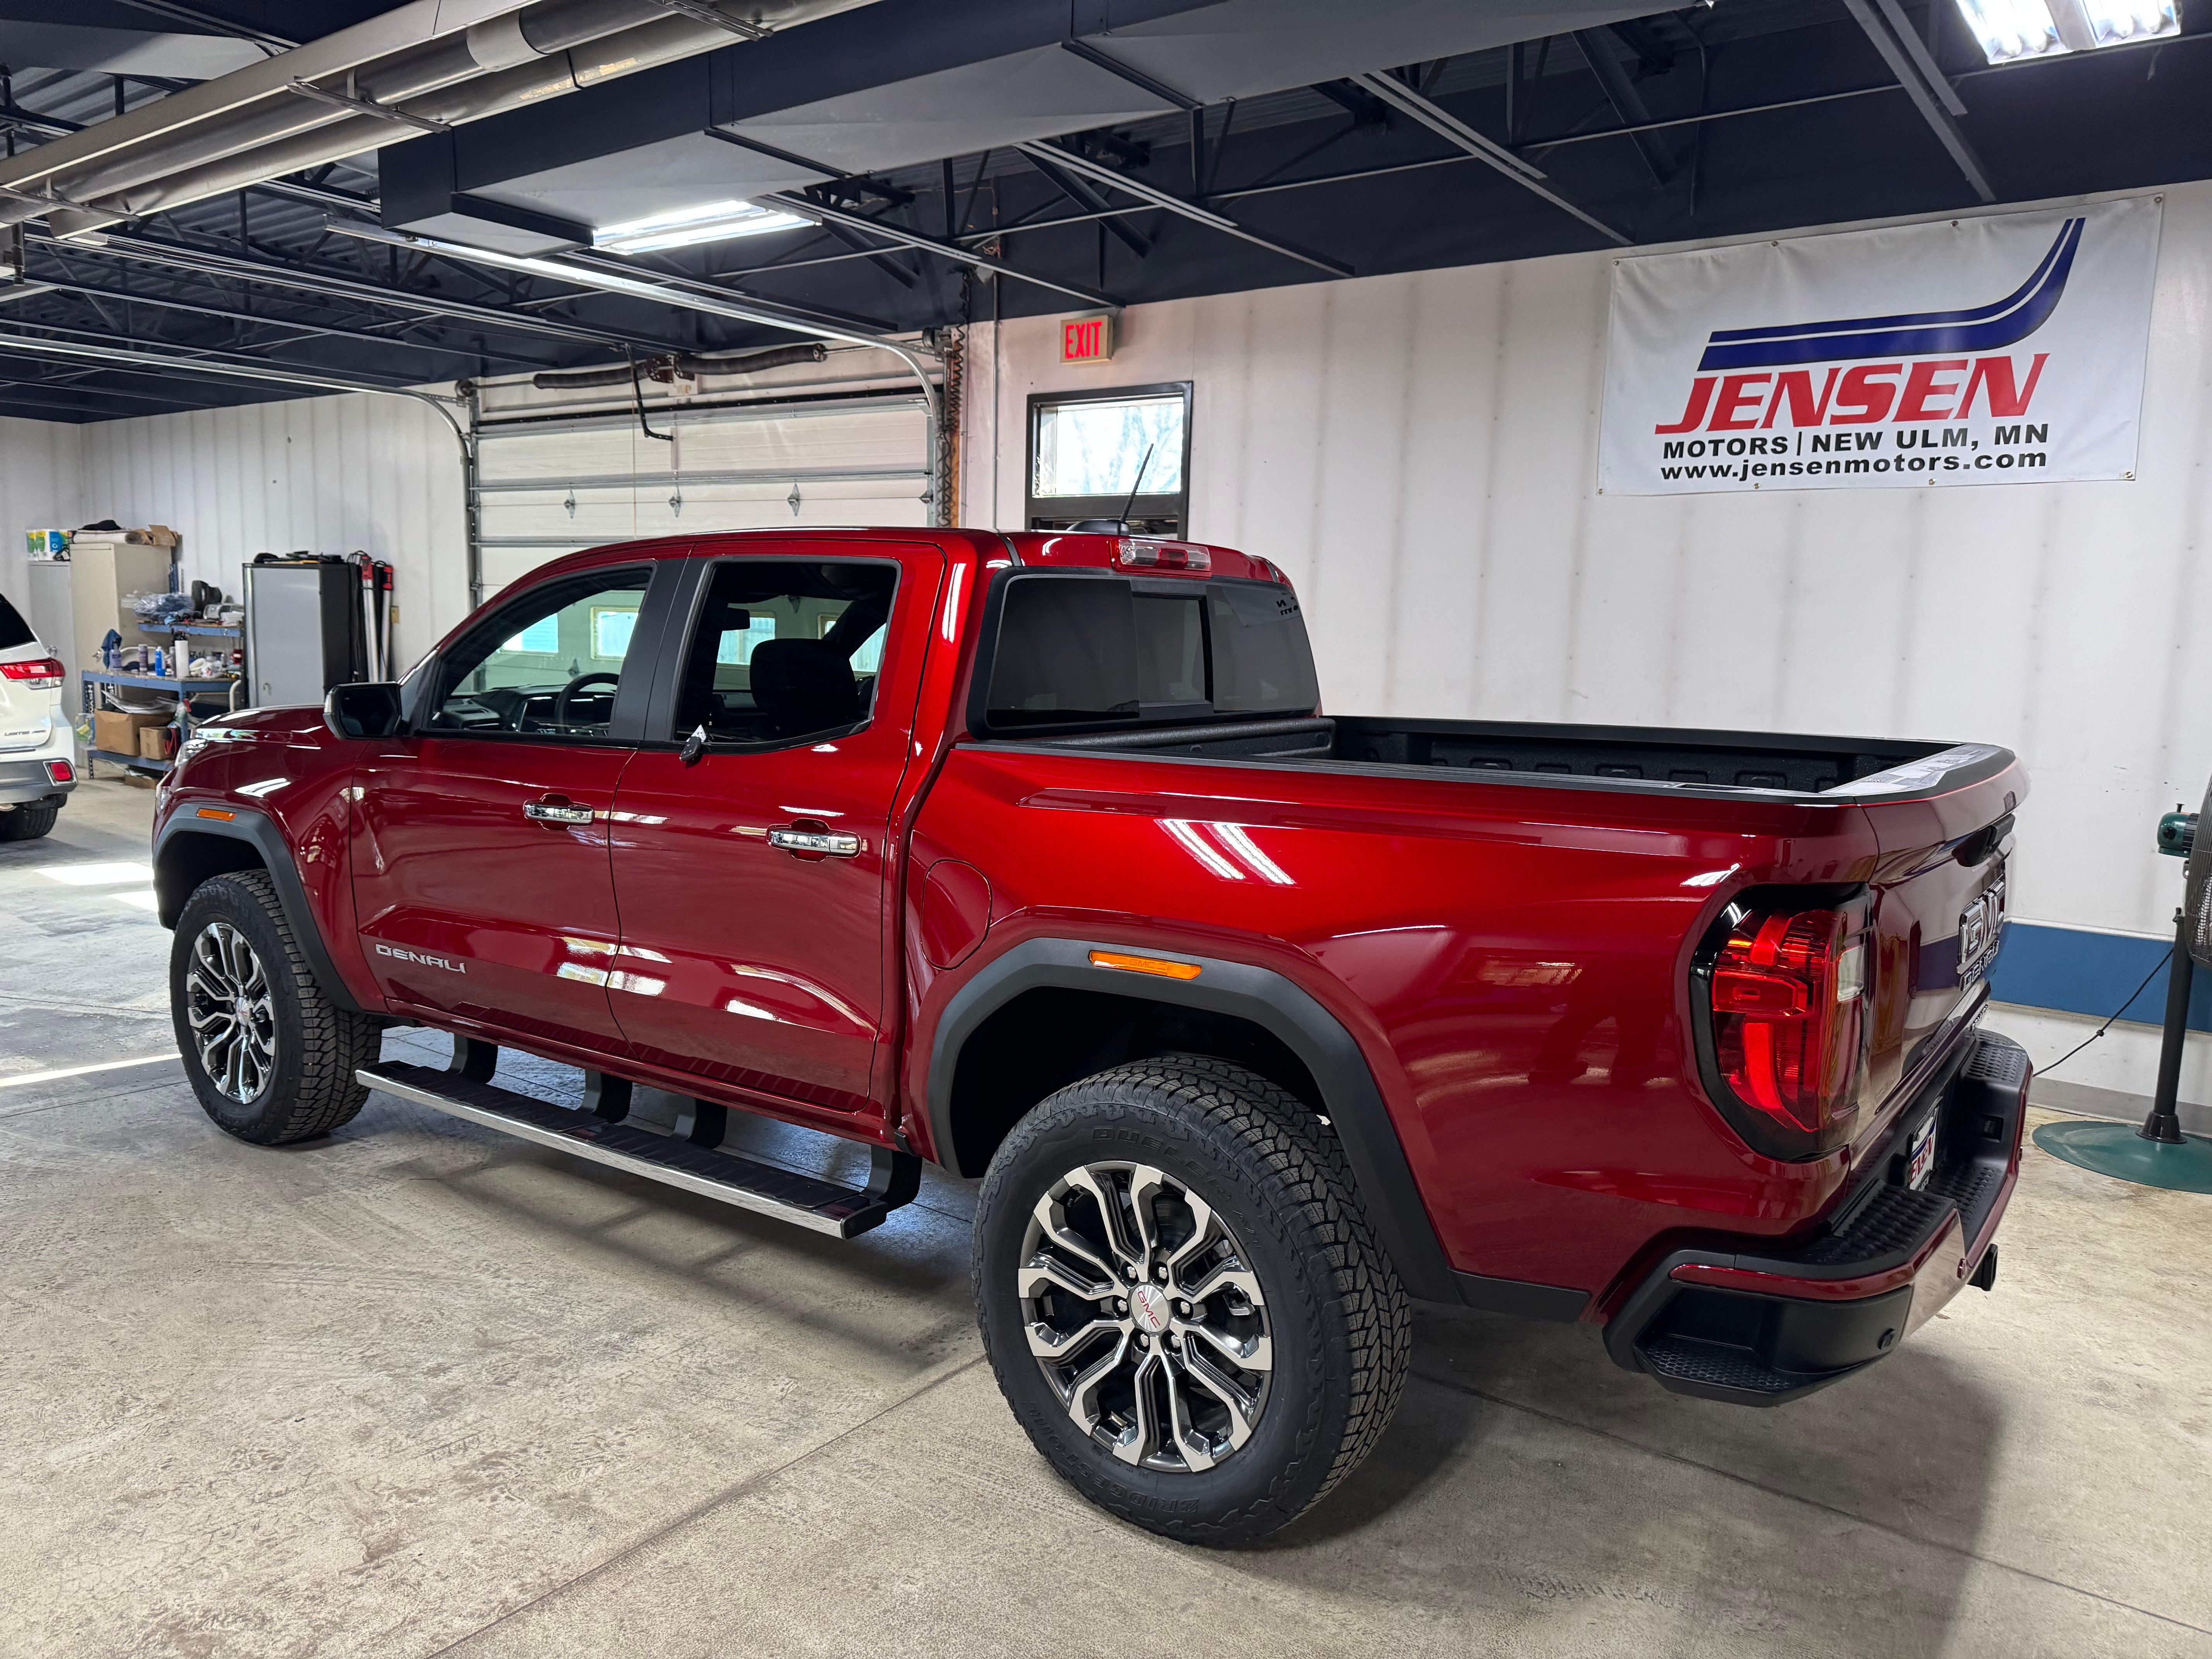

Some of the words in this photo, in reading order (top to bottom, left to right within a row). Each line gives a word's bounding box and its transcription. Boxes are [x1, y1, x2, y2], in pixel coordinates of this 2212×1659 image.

[1065, 321, 1103, 359] EXIT
[1655, 353, 2050, 434] JENSEN
[1663, 436, 1788, 459] MOTORS
[1812, 431, 1883, 453] NEW
[1896, 428, 1978, 451] ULM,
[1994, 423, 2048, 445] MN
[1661, 452, 2046, 481] www.jensenmotors.com
[376, 944, 466, 974] DENALI
[1138, 1291, 1161, 1328] GMC
